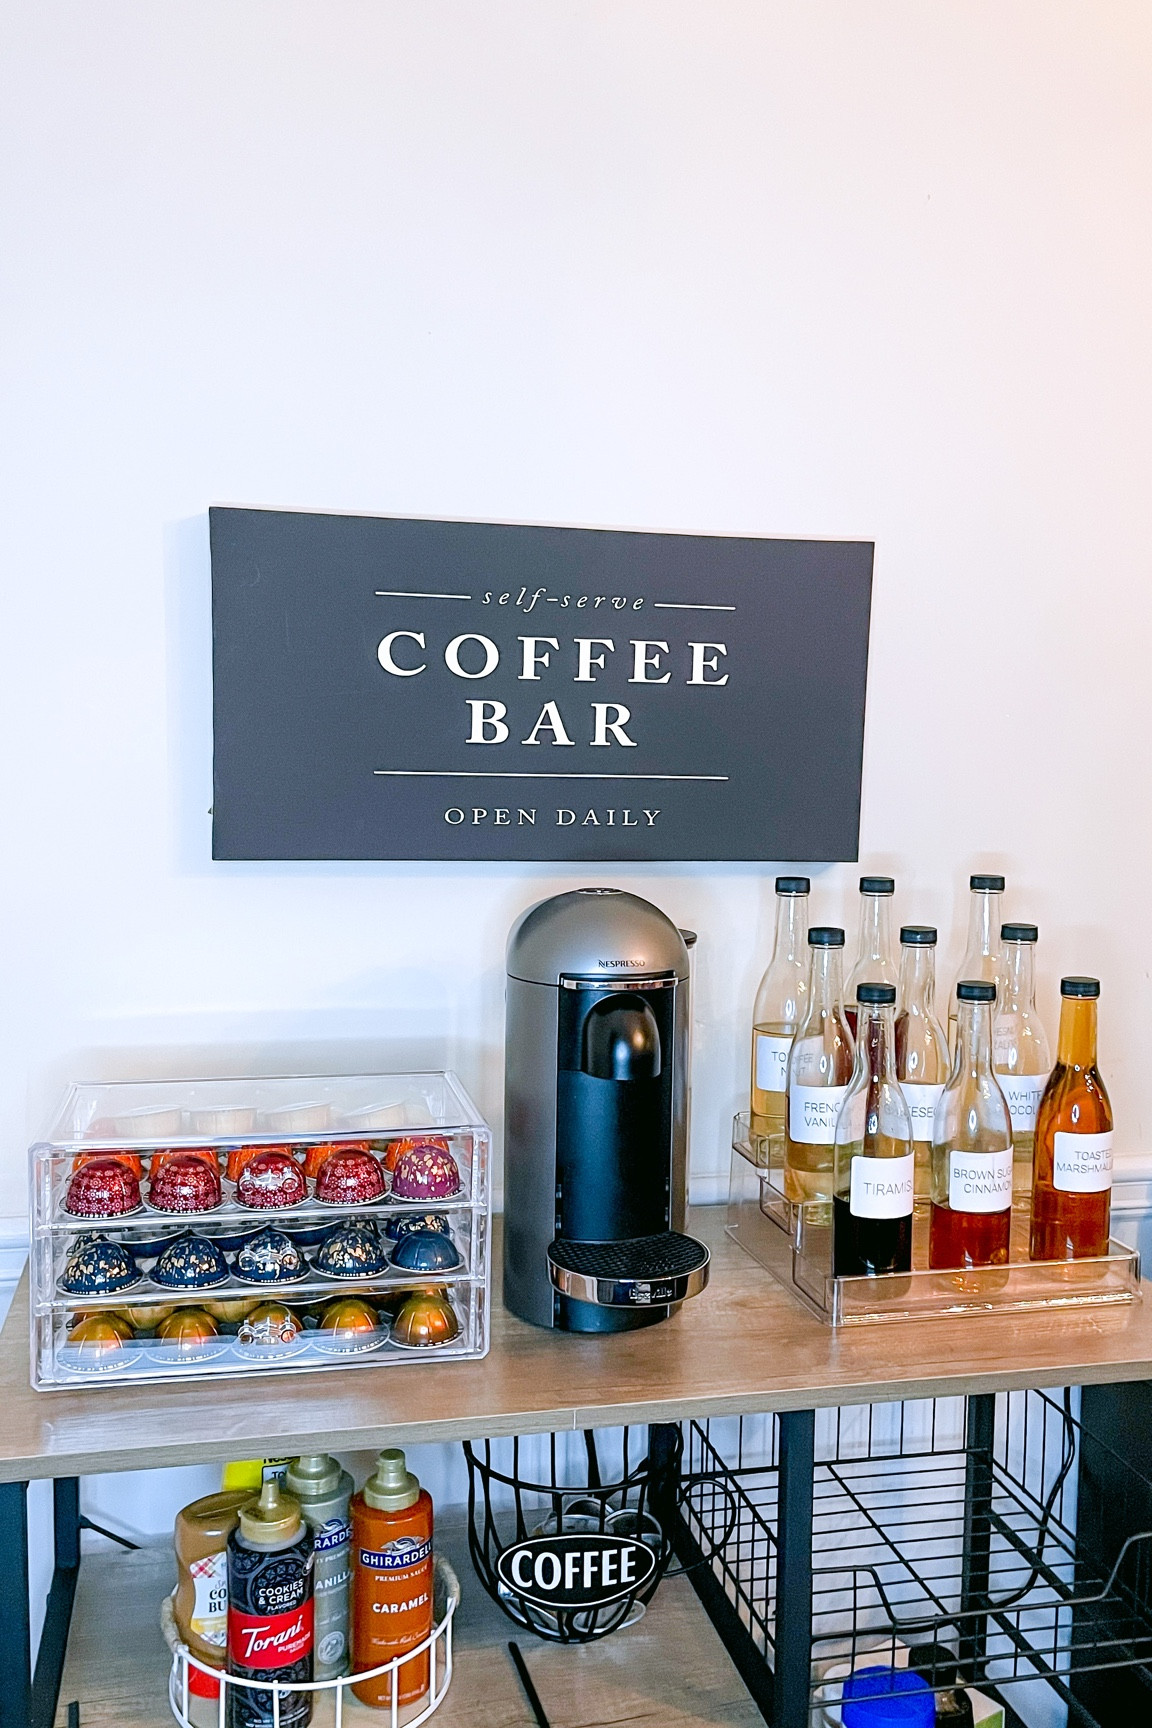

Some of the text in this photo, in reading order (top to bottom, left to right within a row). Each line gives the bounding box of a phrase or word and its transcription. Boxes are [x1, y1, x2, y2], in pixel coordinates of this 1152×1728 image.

[482, 587, 645, 613] self-serve
[376, 630, 730, 686] COFFEE
[464, 698, 638, 747] BAR
[443, 807, 662, 827] OPEN DAILY
[804, 1101, 841, 1114] FRENC
[1074, 1148, 1113, 1161] TOASTE
[953, 1165, 1012, 1181] BROWN SUG
[863, 1180, 913, 1196] TIRAMIS
[362, 1541, 432, 1567] GHIRARDELL
[511, 1545, 636, 1591] COFFEE
[258, 1578, 304, 1597] COOKIES
[258, 1597, 266, 1606] &
[268, 1586, 304, 1605] CREAM
[372, 1592, 429, 1614] CARAMEL
[241, 1614, 303, 1658] Torani
